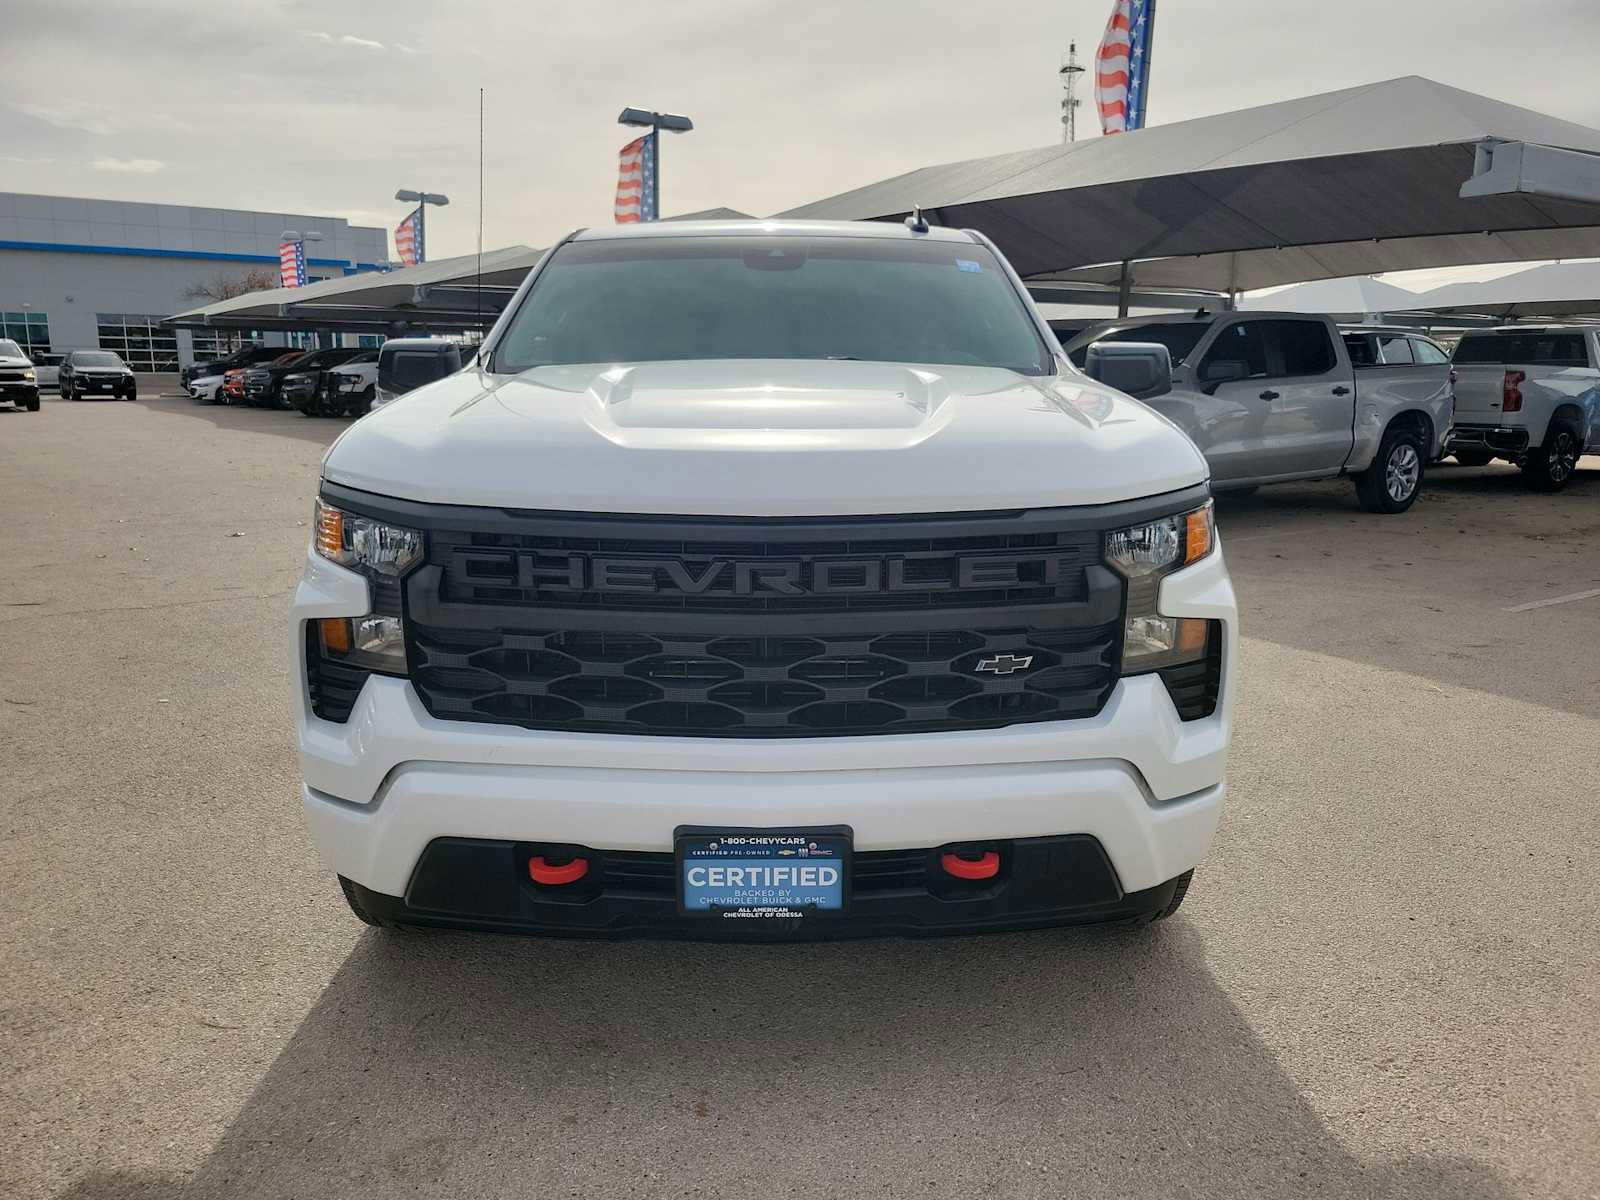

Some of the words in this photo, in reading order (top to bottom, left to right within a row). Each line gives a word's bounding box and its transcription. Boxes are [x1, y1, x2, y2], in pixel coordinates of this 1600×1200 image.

[452, 549, 1078, 595] CHEVROLET
[720, 837, 806, 845] 1-800-CHEVYCARS
[687, 867, 838, 887] CERTIFIED
[734, 889, 775, 897] BACKED
[778, 889, 791, 897] BY
[762, 896, 792, 904] BUICK
[804, 896, 826, 904] GMC
